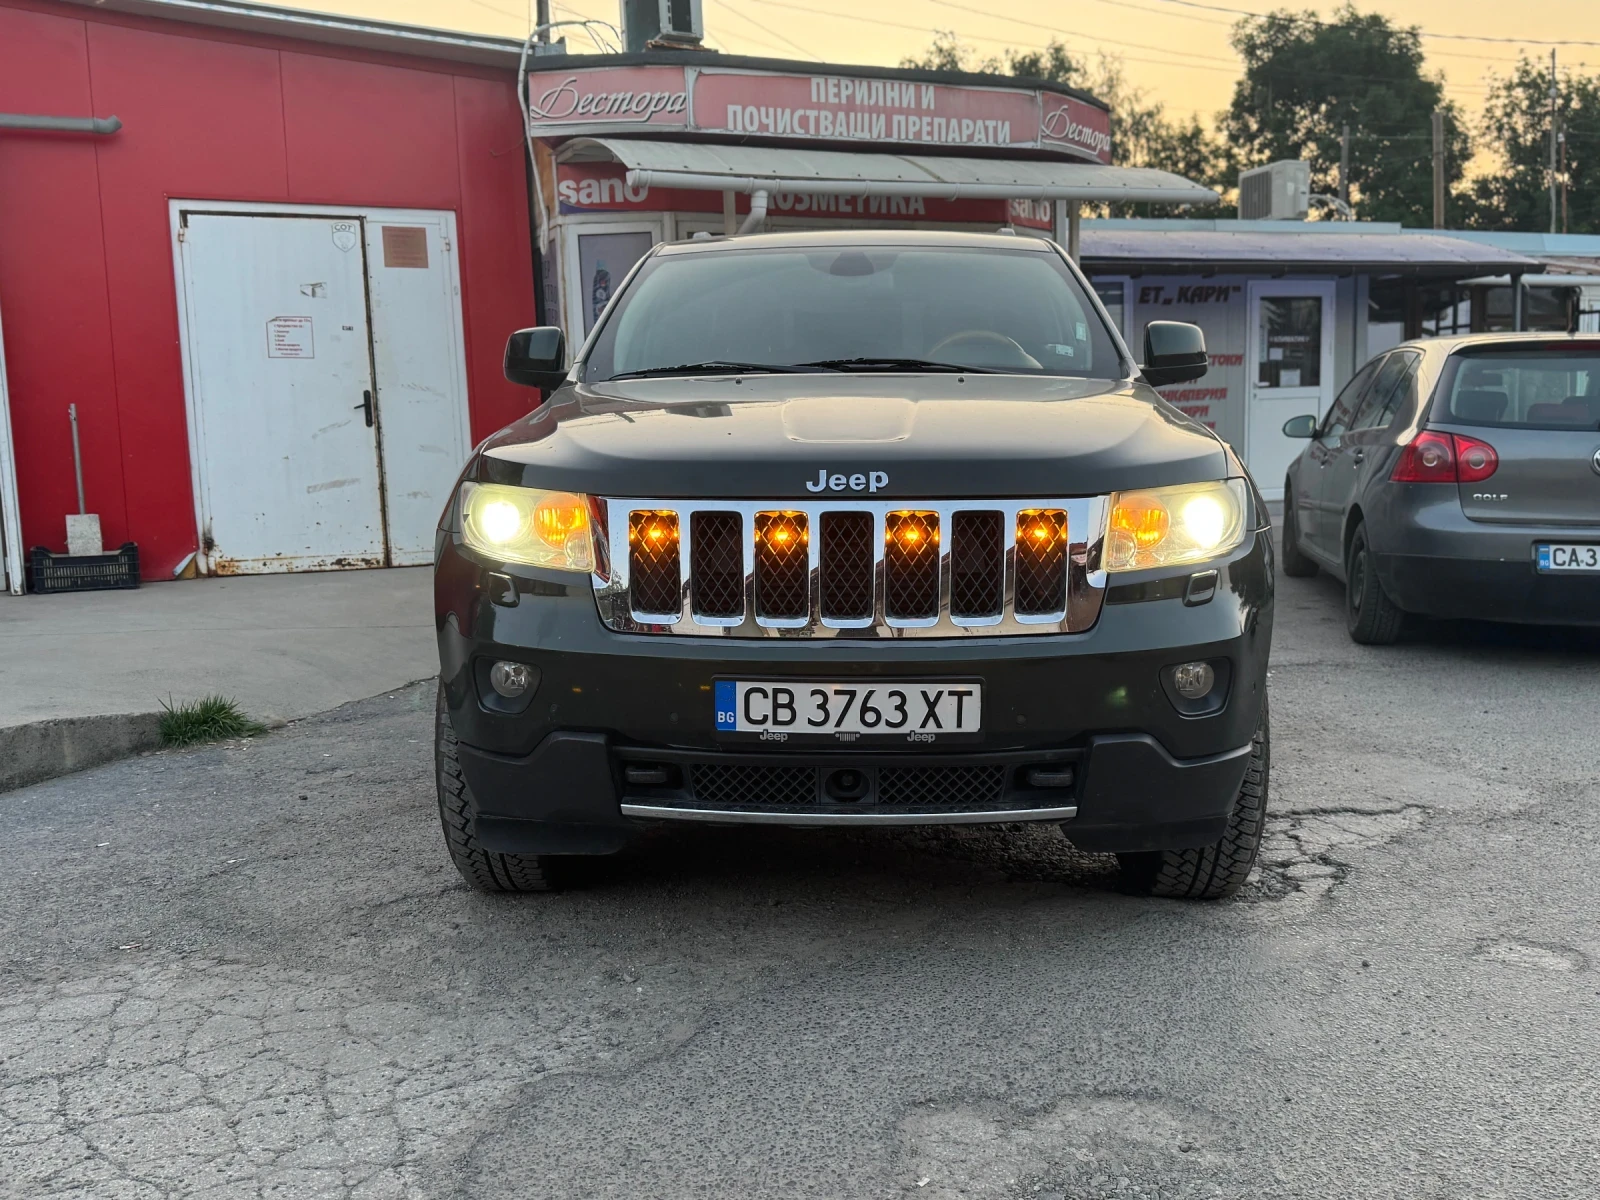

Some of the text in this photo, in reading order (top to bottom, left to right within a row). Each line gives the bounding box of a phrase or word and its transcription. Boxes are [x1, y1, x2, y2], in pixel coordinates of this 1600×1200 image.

[531, 76, 688, 122] Дестора
[811, 77, 935, 110] ПЕРИЛНИ И
[727, 104, 1011, 144] ПОЧИСТВАЩИ ПРЕПАРАТИ
[1041, 105, 1111, 154] Дестора
[558, 178, 649, 205] sano
[1010, 198, 1051, 223] sano
[1138, 286, 1165, 304] ЕТ
[805, 469, 889, 493] Jeep
[1472, 493, 1509, 501] GOLF
[1539, 559, 1550, 567] BG
[1553, 547, 1581, 567] CA
[717, 686, 973, 729] BG CB 3763 XT
[759, 729, 789, 742] Jeep
[906, 730, 936, 743] Jeep
